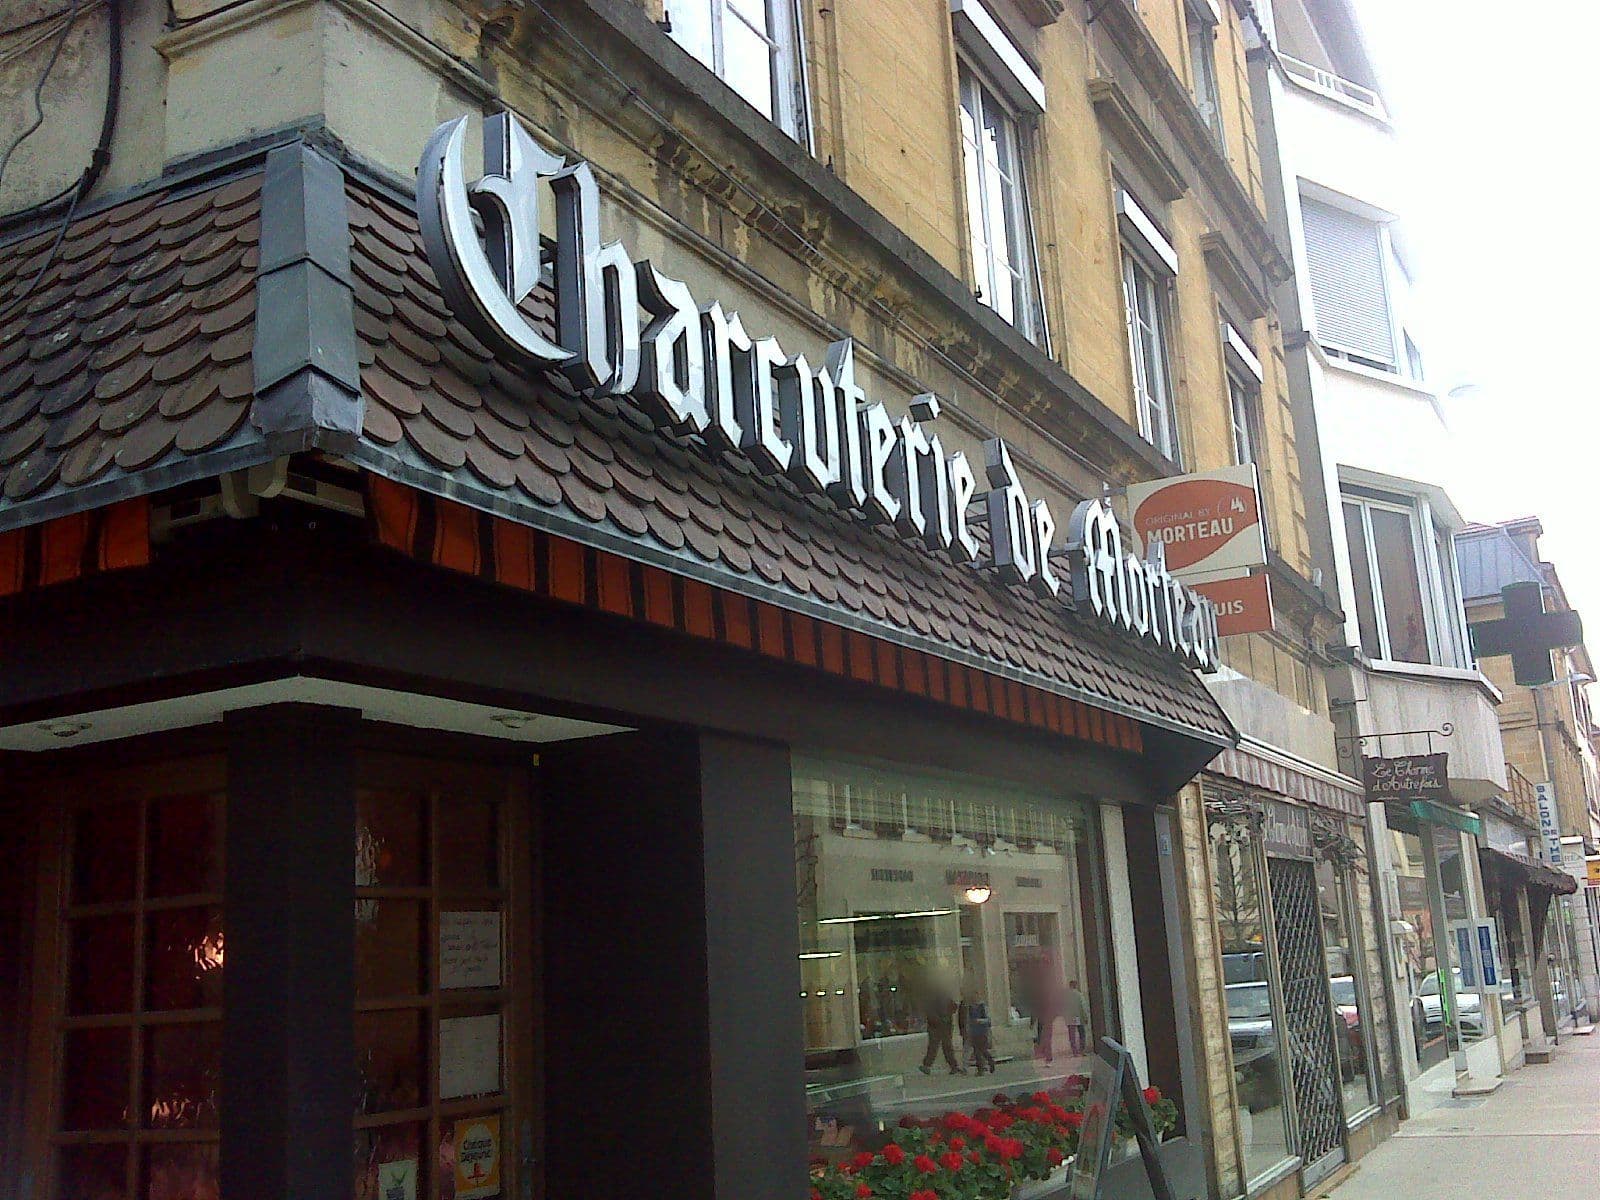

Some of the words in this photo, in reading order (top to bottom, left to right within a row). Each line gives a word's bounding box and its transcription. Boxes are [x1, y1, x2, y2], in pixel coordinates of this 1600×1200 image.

[417, 111, 980, 561] Charcuterie
[986, 438, 1061, 597] de
[1066, 483, 1219, 673] Morteau
[1145, 511, 1193, 526] ORIGINAL
[1147, 517, 1233, 545] MORTEAU
[1214, 600, 1244, 616] UIS
